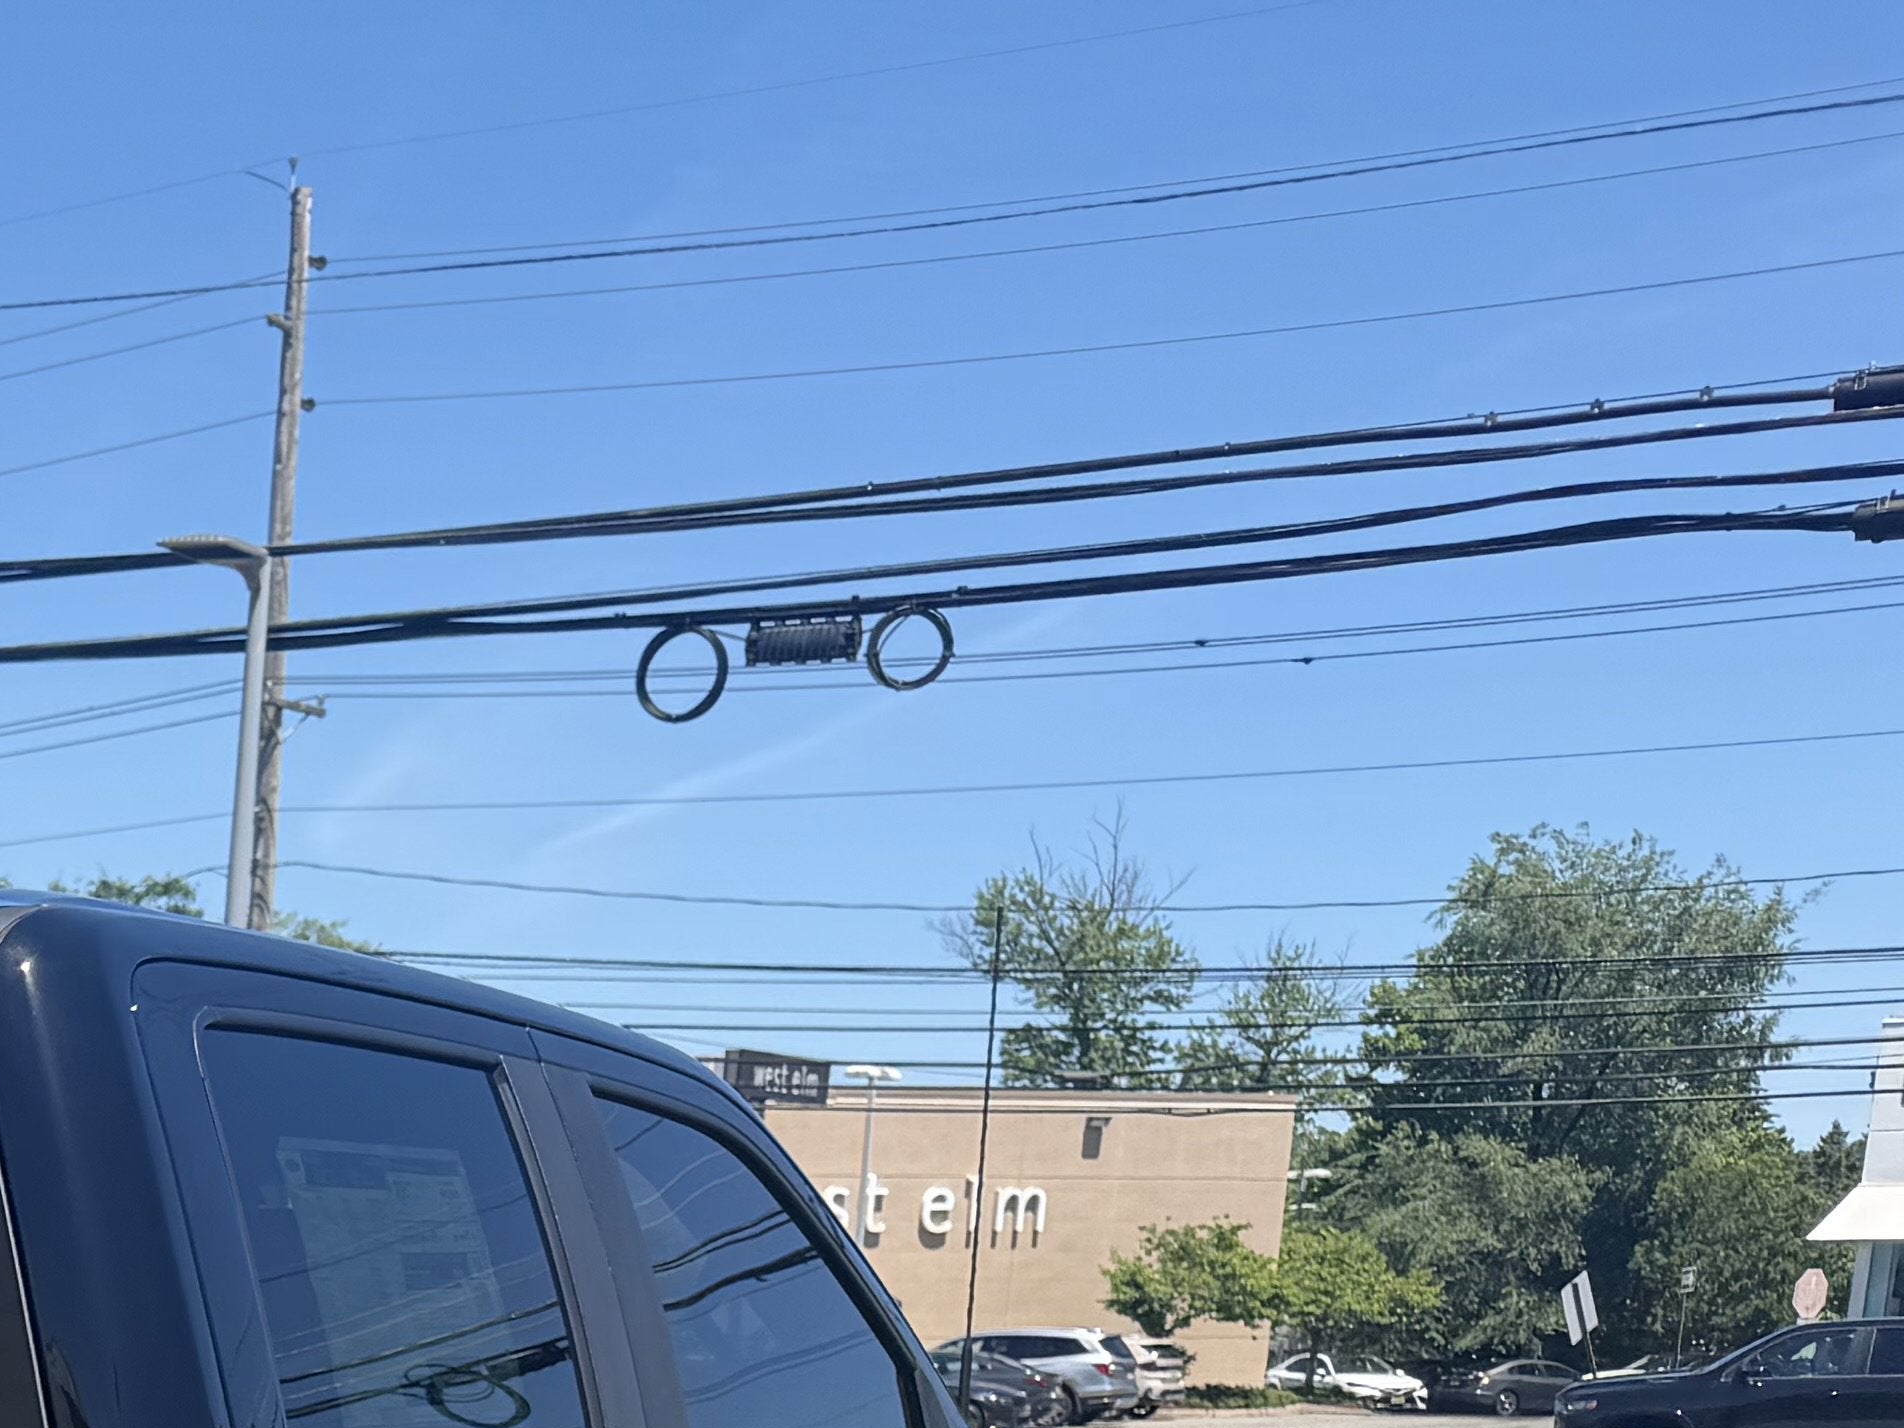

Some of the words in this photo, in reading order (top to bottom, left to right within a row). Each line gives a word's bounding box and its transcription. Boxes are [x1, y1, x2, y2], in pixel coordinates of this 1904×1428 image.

[754, 1063, 789, 1095] west
[791, 1065, 819, 1097] elm
[824, 1172, 889, 1234] st
[922, 1174, 1047, 1234] elm
